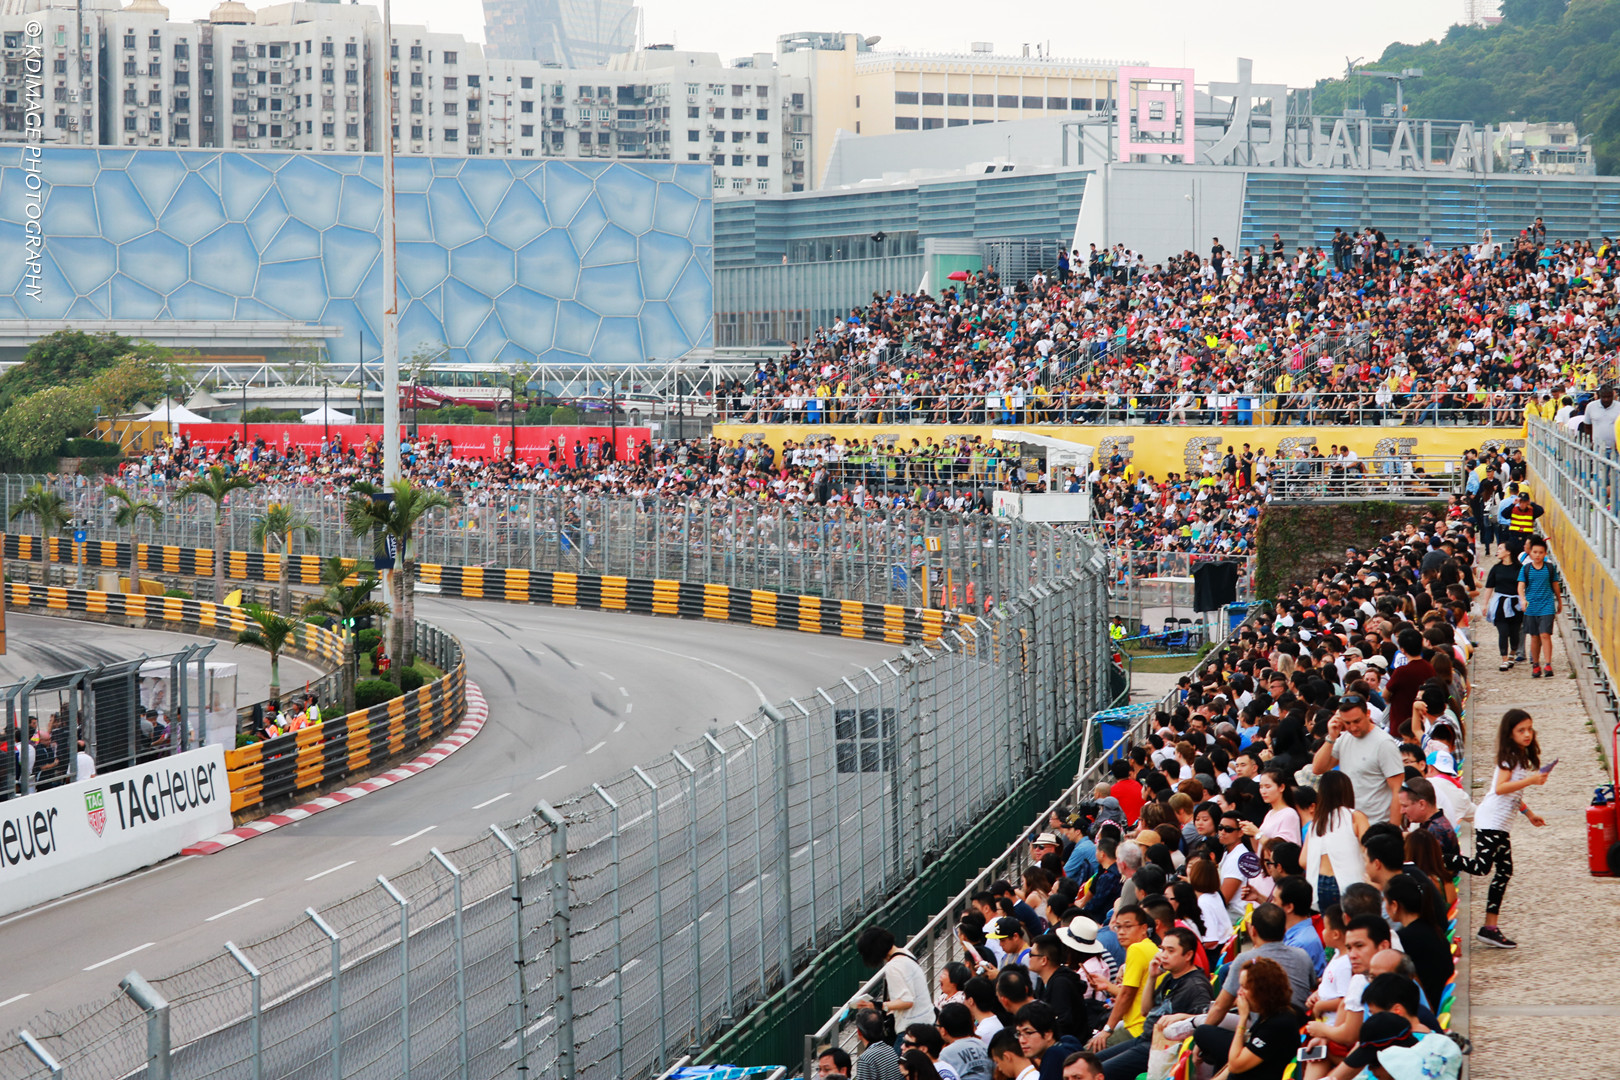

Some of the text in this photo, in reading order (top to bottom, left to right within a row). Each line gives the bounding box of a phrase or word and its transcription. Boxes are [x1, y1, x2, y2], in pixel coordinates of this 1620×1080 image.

[1118, 57, 1287, 165] 回力
[1386, 121, 1494, 173] ALAI
[85, 793, 104, 809] TAG
